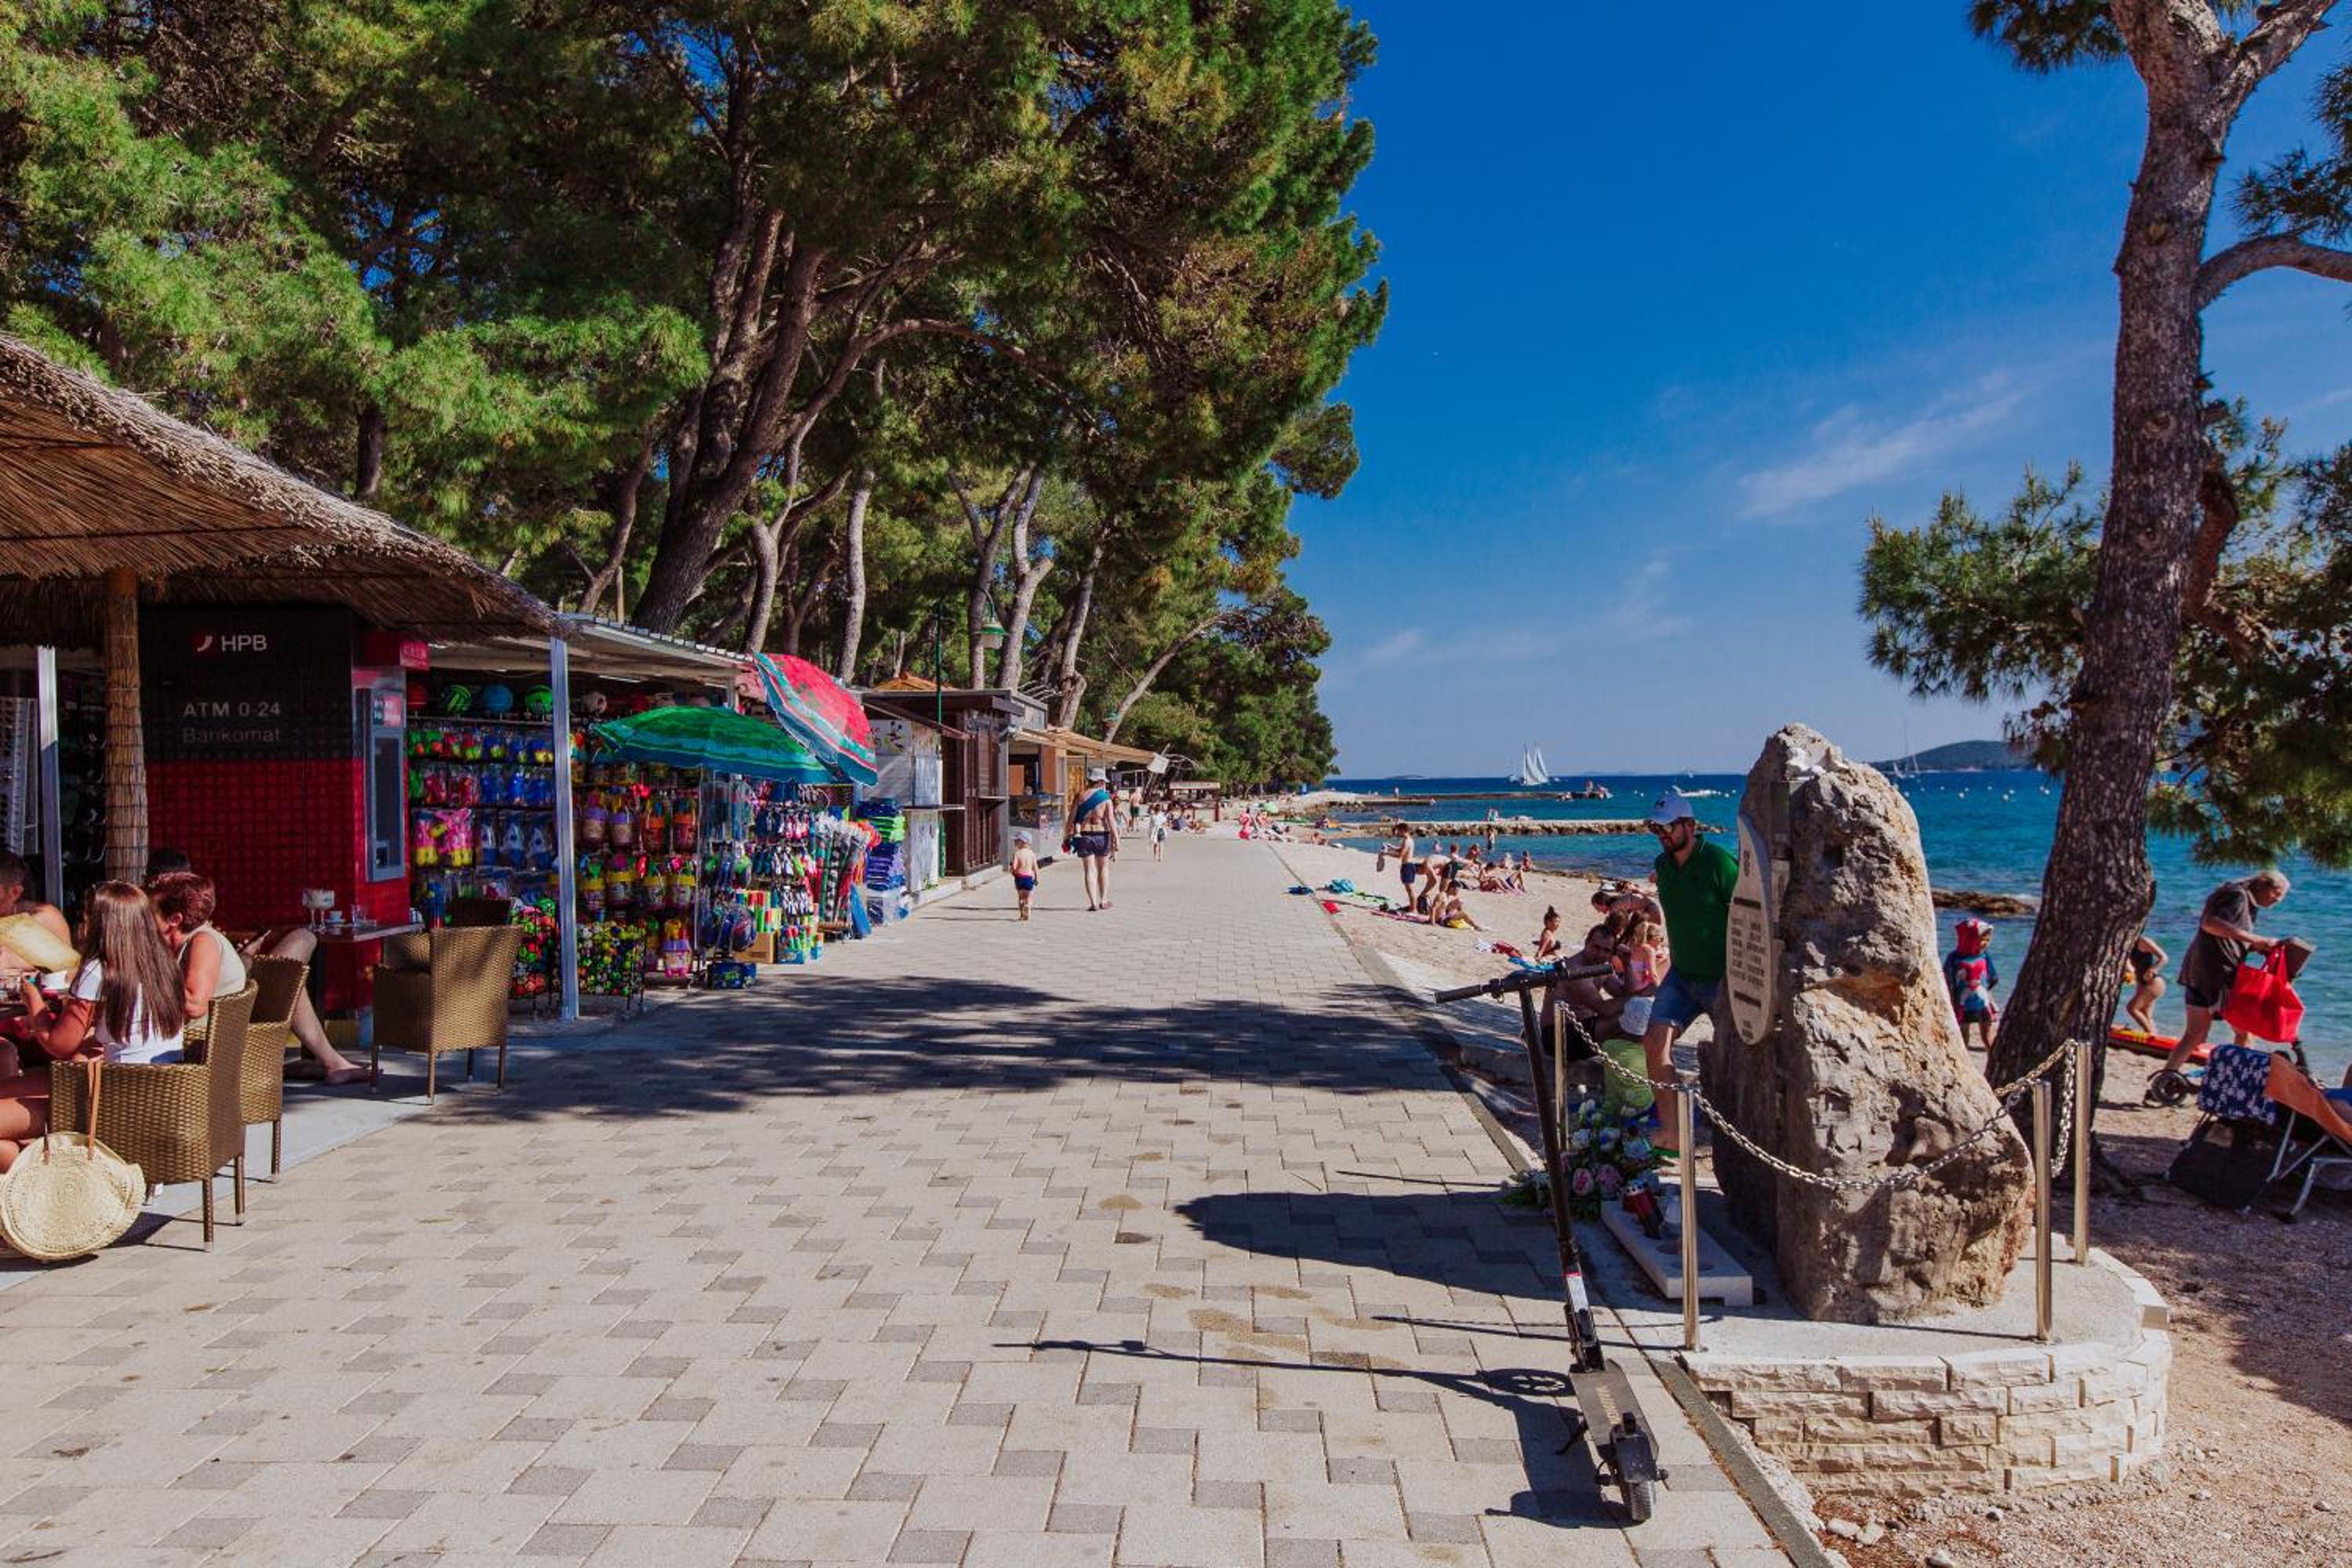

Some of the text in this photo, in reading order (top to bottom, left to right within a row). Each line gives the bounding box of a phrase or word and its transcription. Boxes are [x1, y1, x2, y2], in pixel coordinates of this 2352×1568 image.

[222, 636, 267, 652] HPB
[183, 702, 230, 717] ATM
[183, 728, 280, 742] Bankomat
